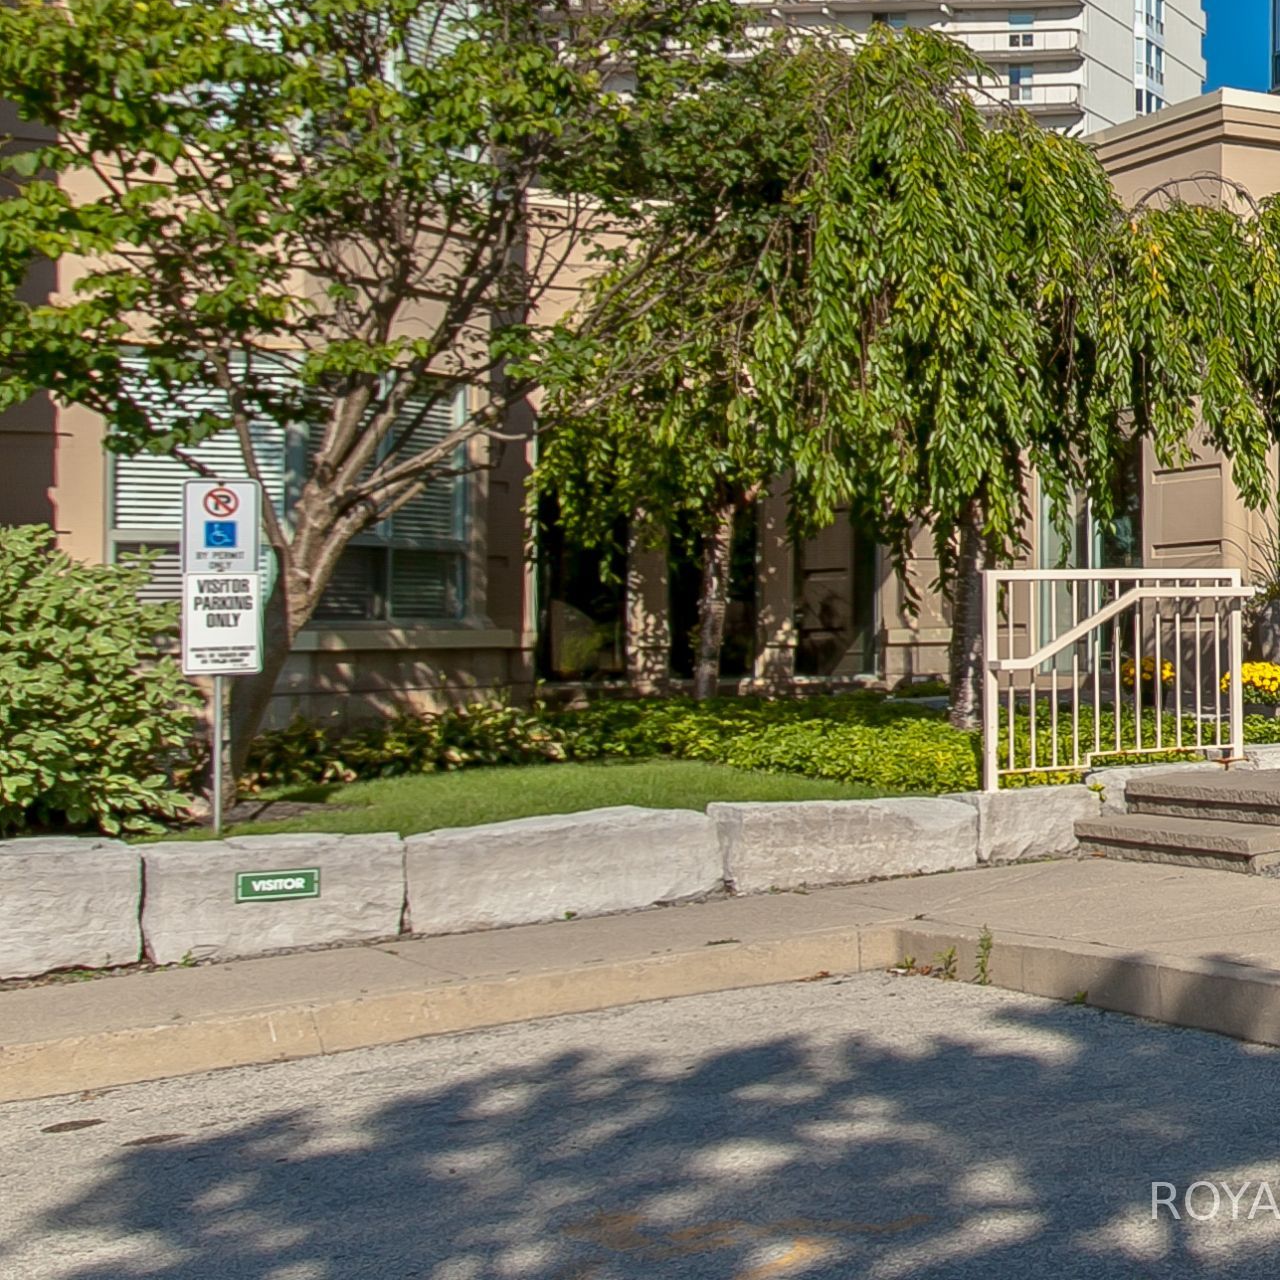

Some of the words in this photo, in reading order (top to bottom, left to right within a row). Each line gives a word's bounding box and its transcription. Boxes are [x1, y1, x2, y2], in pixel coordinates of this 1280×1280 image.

[197, 579, 250, 593] VISITOR
[194, 595, 253, 610] PARKING
[206, 613, 241, 627] ONLY
[251, 877, 306, 892] VISITOR
